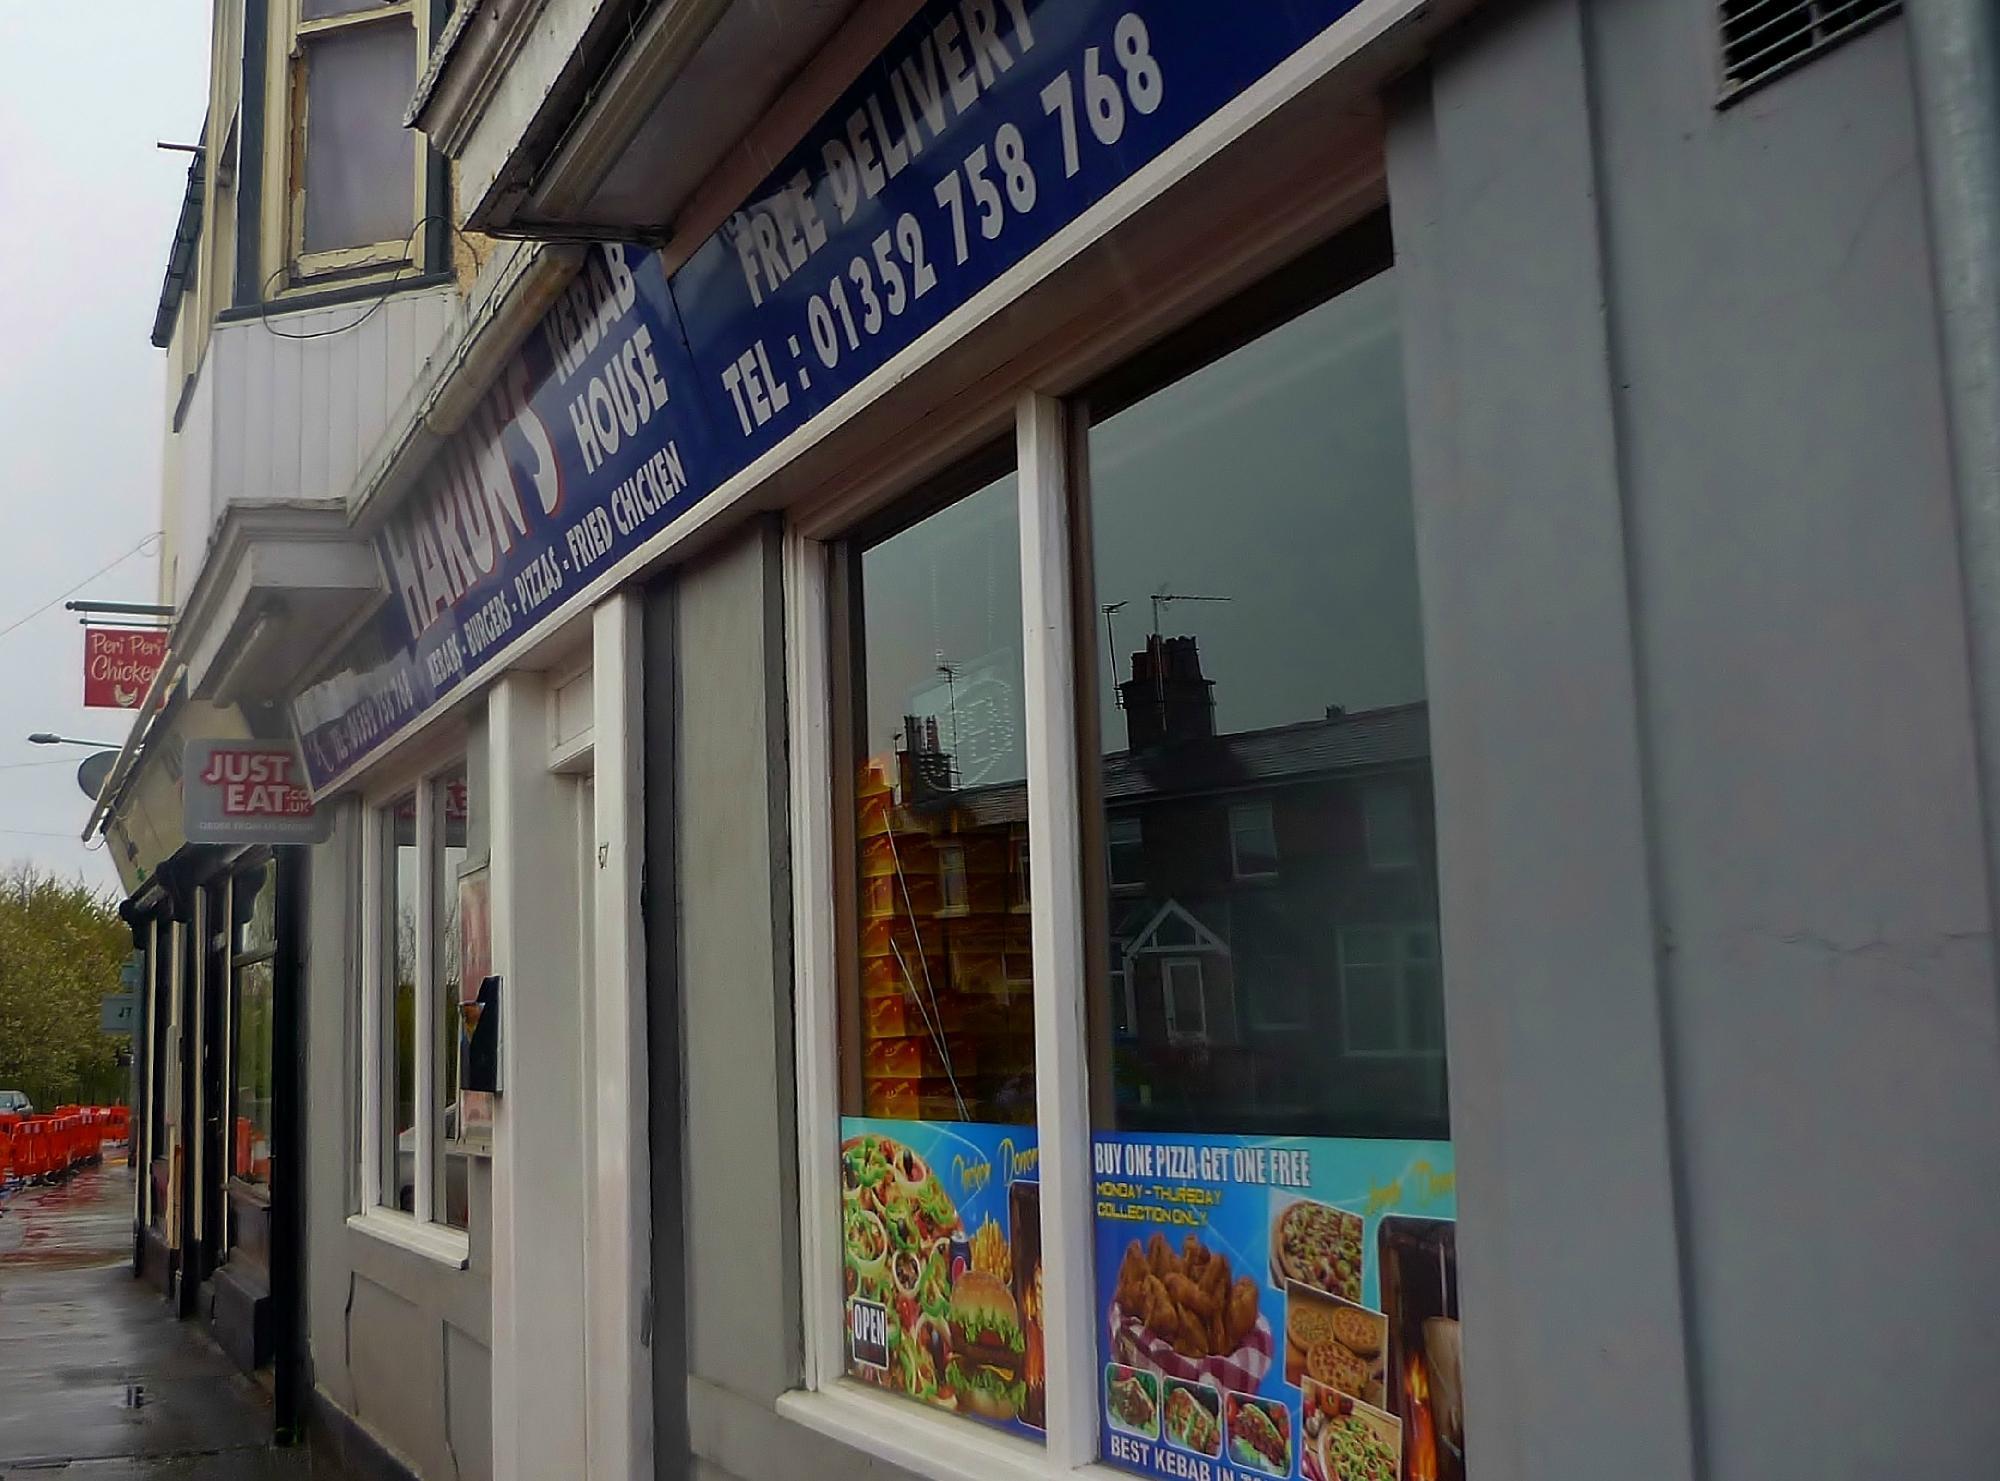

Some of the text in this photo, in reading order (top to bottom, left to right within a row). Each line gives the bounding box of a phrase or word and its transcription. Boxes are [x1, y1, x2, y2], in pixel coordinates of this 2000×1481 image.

[734, 0, 1036, 307] FREE DELIVERY
[807, 212, 936, 370] 01352
[934, 122, 1037, 266] 758
[1041, 12, 1163, 179] 768
[545, 243, 636, 385] KEBAB
[569, 324, 669, 475] HOUSE
[463, 590, 512, 659] BURGERS
[514, 545, 564, 614] PIZZAS
[566, 506, 612, 573] FRIED
[611, 441, 687, 545] CHICKEN
[91, 633, 164, 656] Peri Peri
[205, 754, 289, 782] JUST
[227, 785, 289, 812] EAT
[1095, 1143, 1312, 1187] BUY ONE PIZZA GET ONE FREE
[1096, 1182, 1143, 1199] MONDAY
[1153, 1186, 1222, 1206] THURSDAY
[1097, 1202, 1208, 1227] COLLECTION ONLY
[854, 1303, 885, 1347] OPEN
[1111, 1435, 1150, 1466] BEST
[1154, 1448, 1211, 1481] KEBAB
